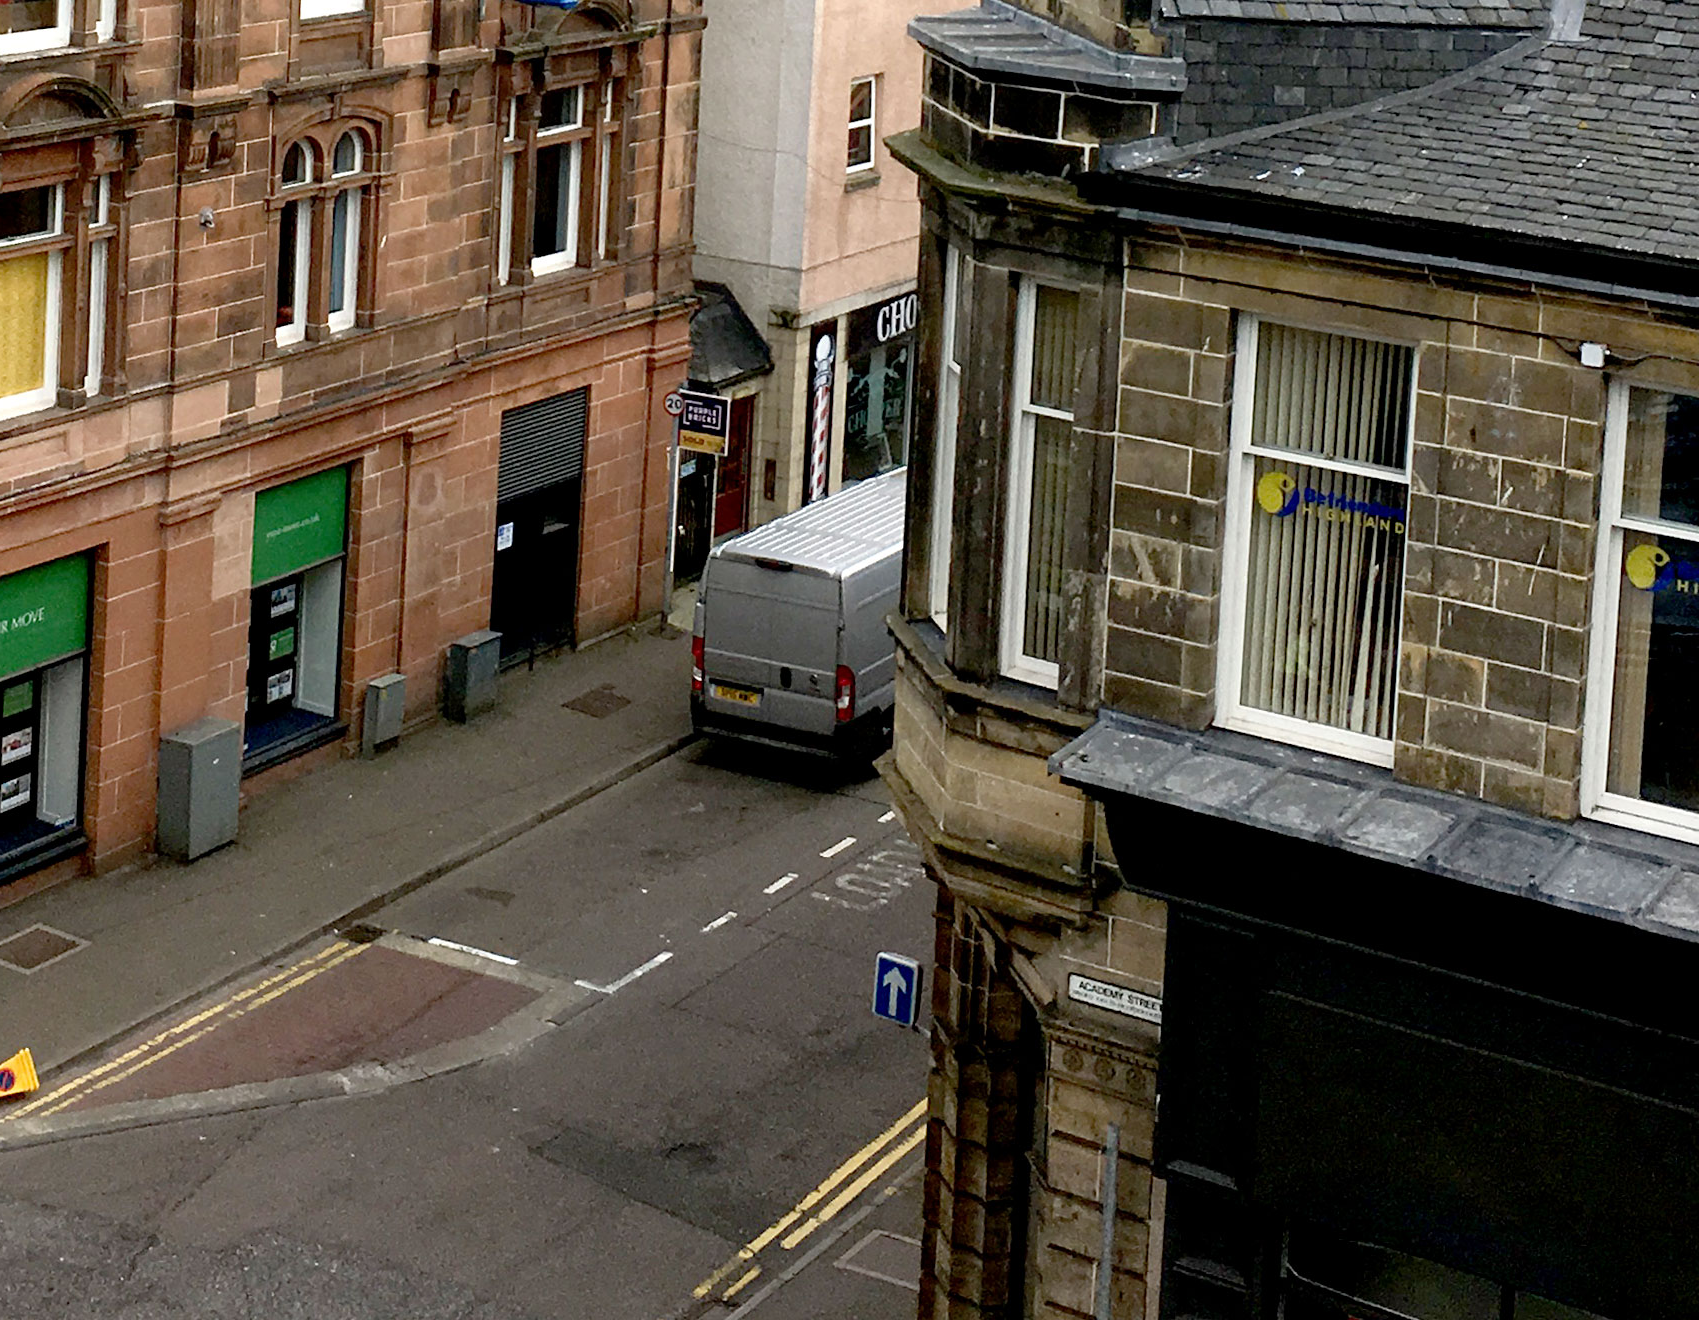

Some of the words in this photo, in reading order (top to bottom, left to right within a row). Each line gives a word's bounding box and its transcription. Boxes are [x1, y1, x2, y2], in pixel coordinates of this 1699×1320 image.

[666, 398, 682, 409] 20
[688, 405, 717, 417] PURPLE
[687, 413, 717, 425] BRICKS
[1303, 502, 1404, 535] HIGHLAND
[11, 607, 45, 630] MOVE
[1079, 981, 1124, 1001] ACADEMY
